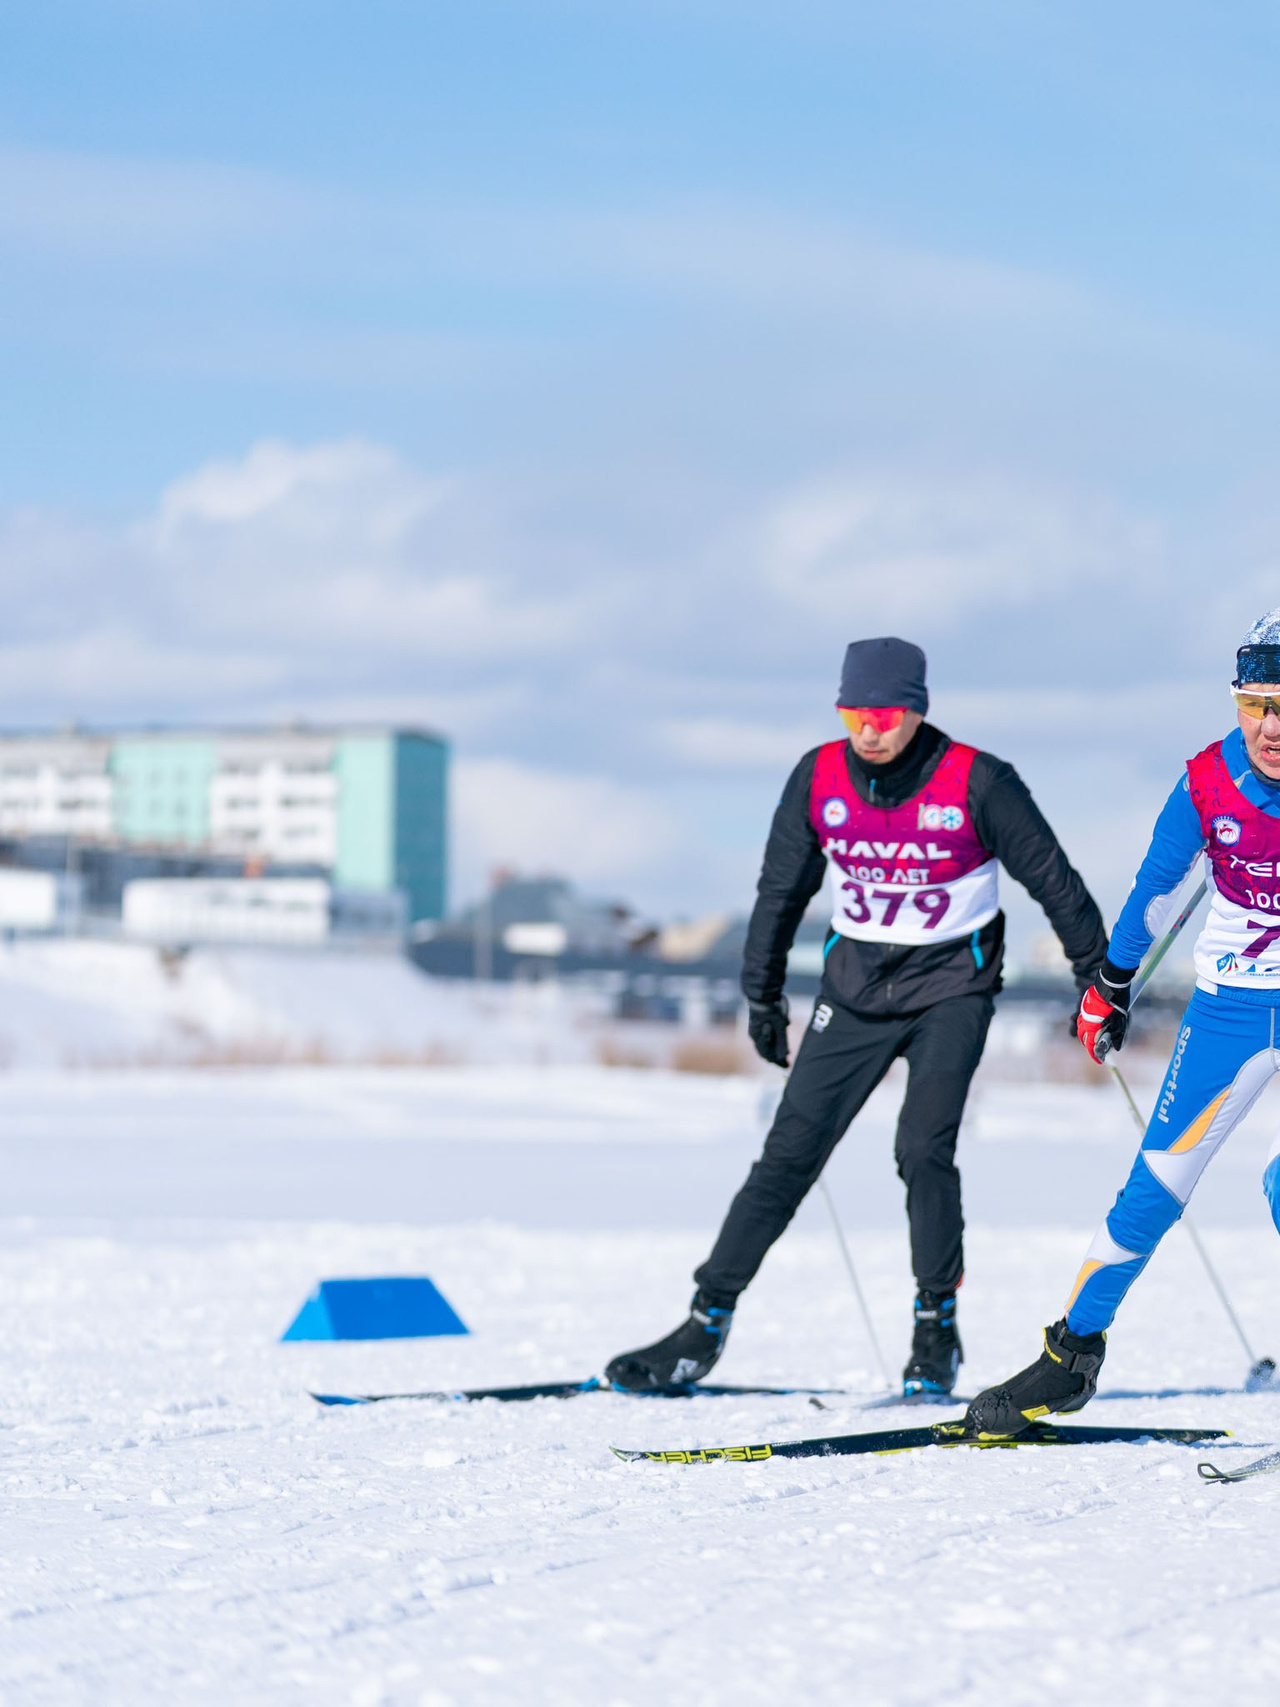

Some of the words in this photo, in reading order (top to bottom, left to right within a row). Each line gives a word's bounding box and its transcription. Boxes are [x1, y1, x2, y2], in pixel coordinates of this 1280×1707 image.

[824, 837, 952, 860] HAVAL
[847, 865, 886, 882] 100
[891, 868, 930, 884] ЛЕТ
[841, 881, 950, 930] 379
[1157, 1025, 1191, 1124] sportful
